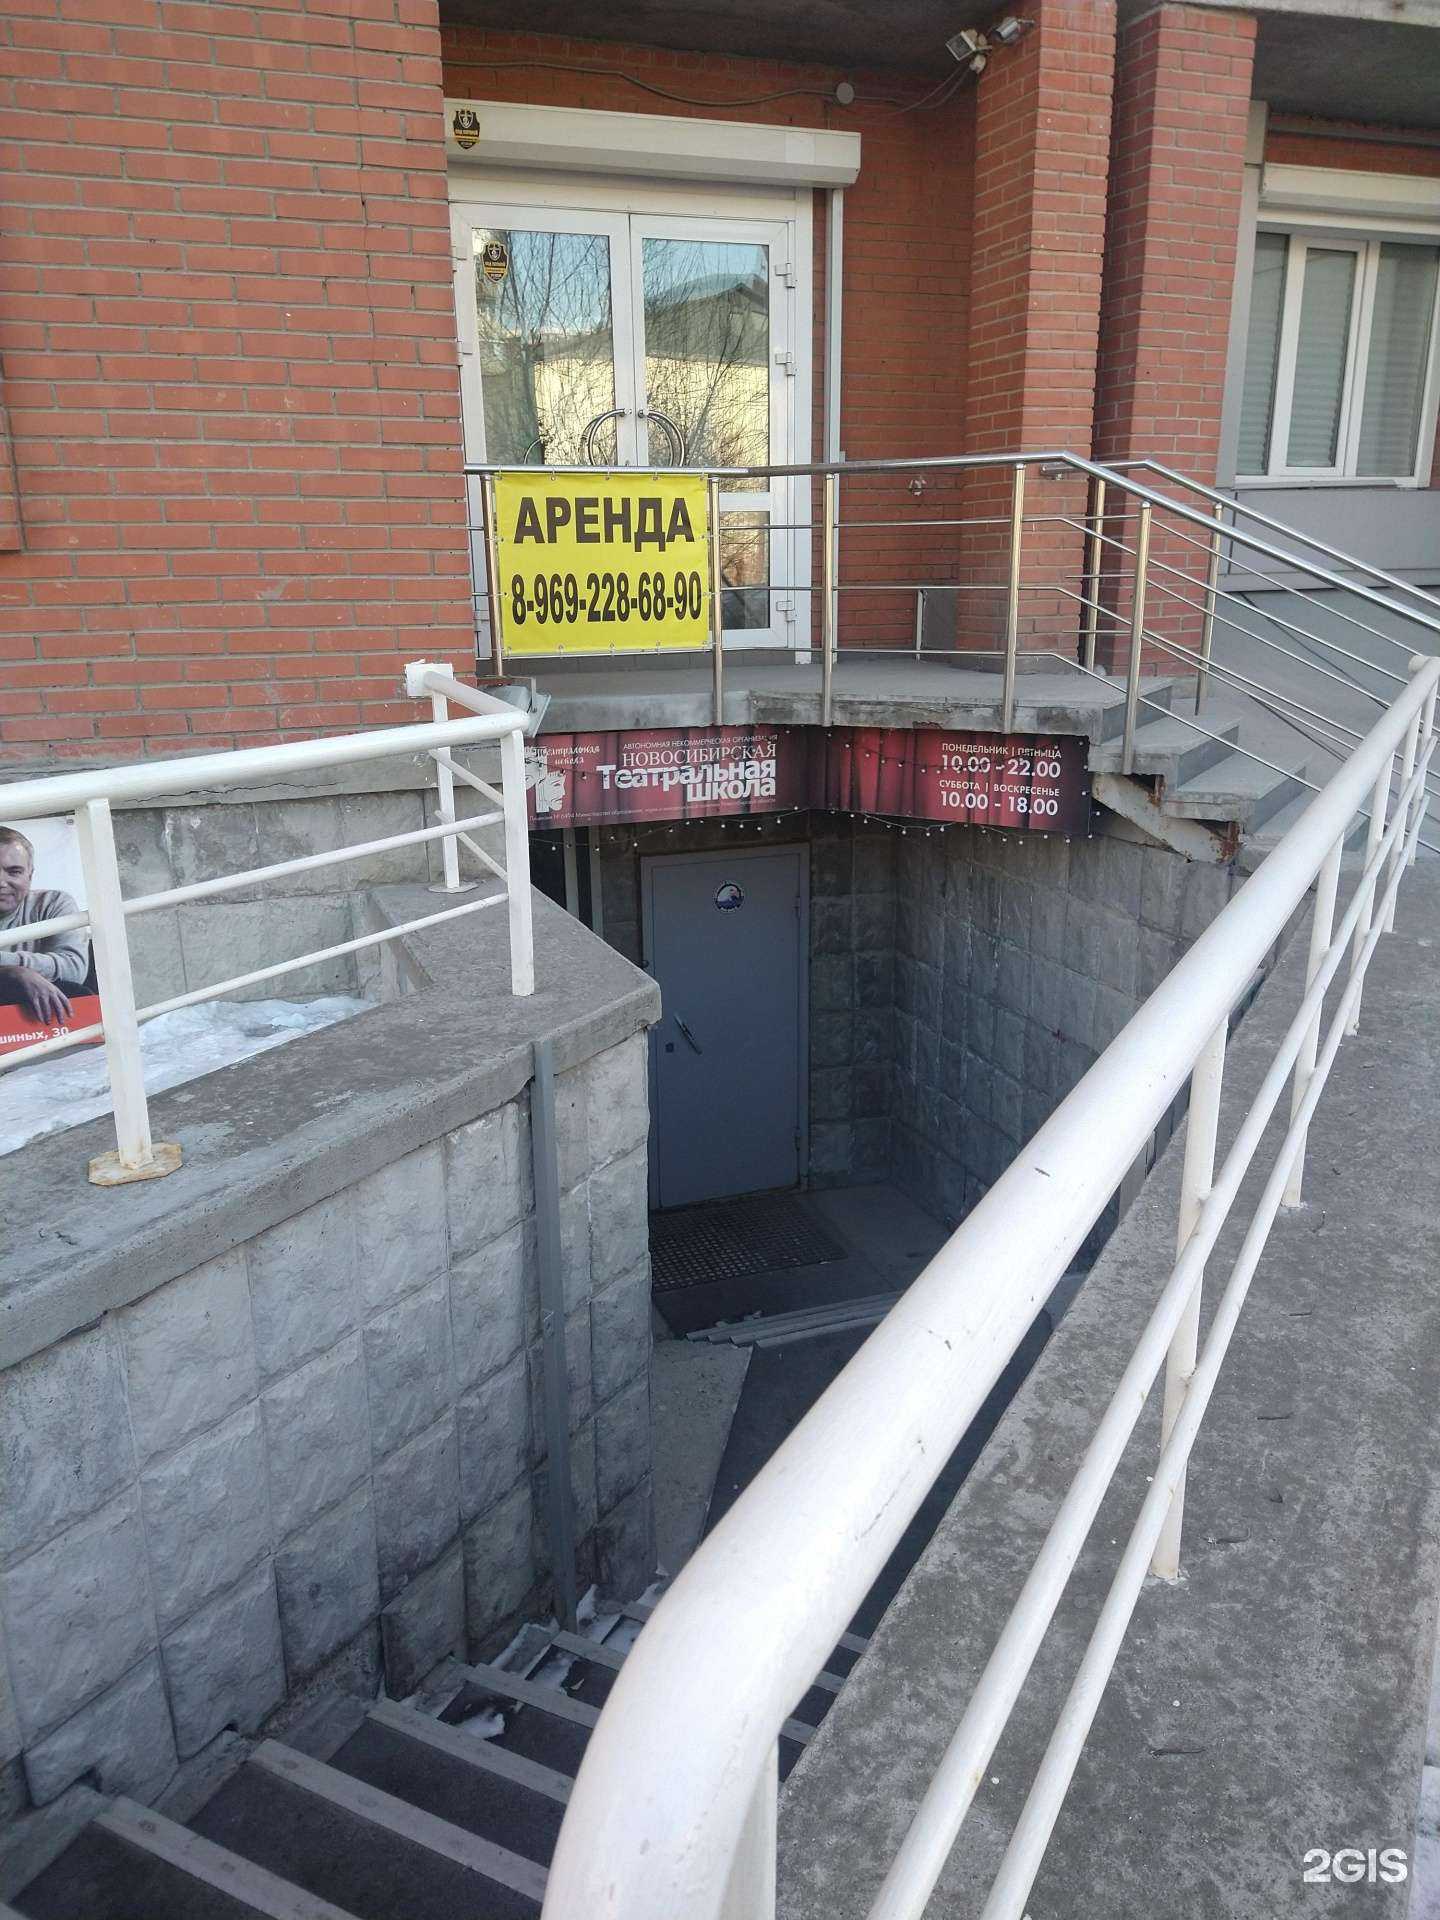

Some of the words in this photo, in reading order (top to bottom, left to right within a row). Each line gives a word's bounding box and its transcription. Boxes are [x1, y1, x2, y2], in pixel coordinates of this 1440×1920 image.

[513, 496, 695, 552] АРЕНДА
[511, 571, 702, 625] 8-969-228-68-90
[622, 743, 777, 767] НОВОСИБИРСКАЯ
[623, 741, 671, 750] АВТОНОМНАЯ
[942, 743, 1009, 755] ПОНЕДЕЛЬНИК
[1017, 747, 1062, 759] ПЯТНИЦА
[596, 759, 776, 791] Театральная
[942, 754, 991, 774] 10.00
[1007, 758, 1061, 778] 22.00
[687, 777, 776, 802] школа
[939, 779, 981, 790] СУББОТА
[993, 783, 1060, 797] ВОСКРЕСЕНЬЕ
[940, 790, 989, 810] 10.00
[1008, 796, 1058, 816] 18.00
